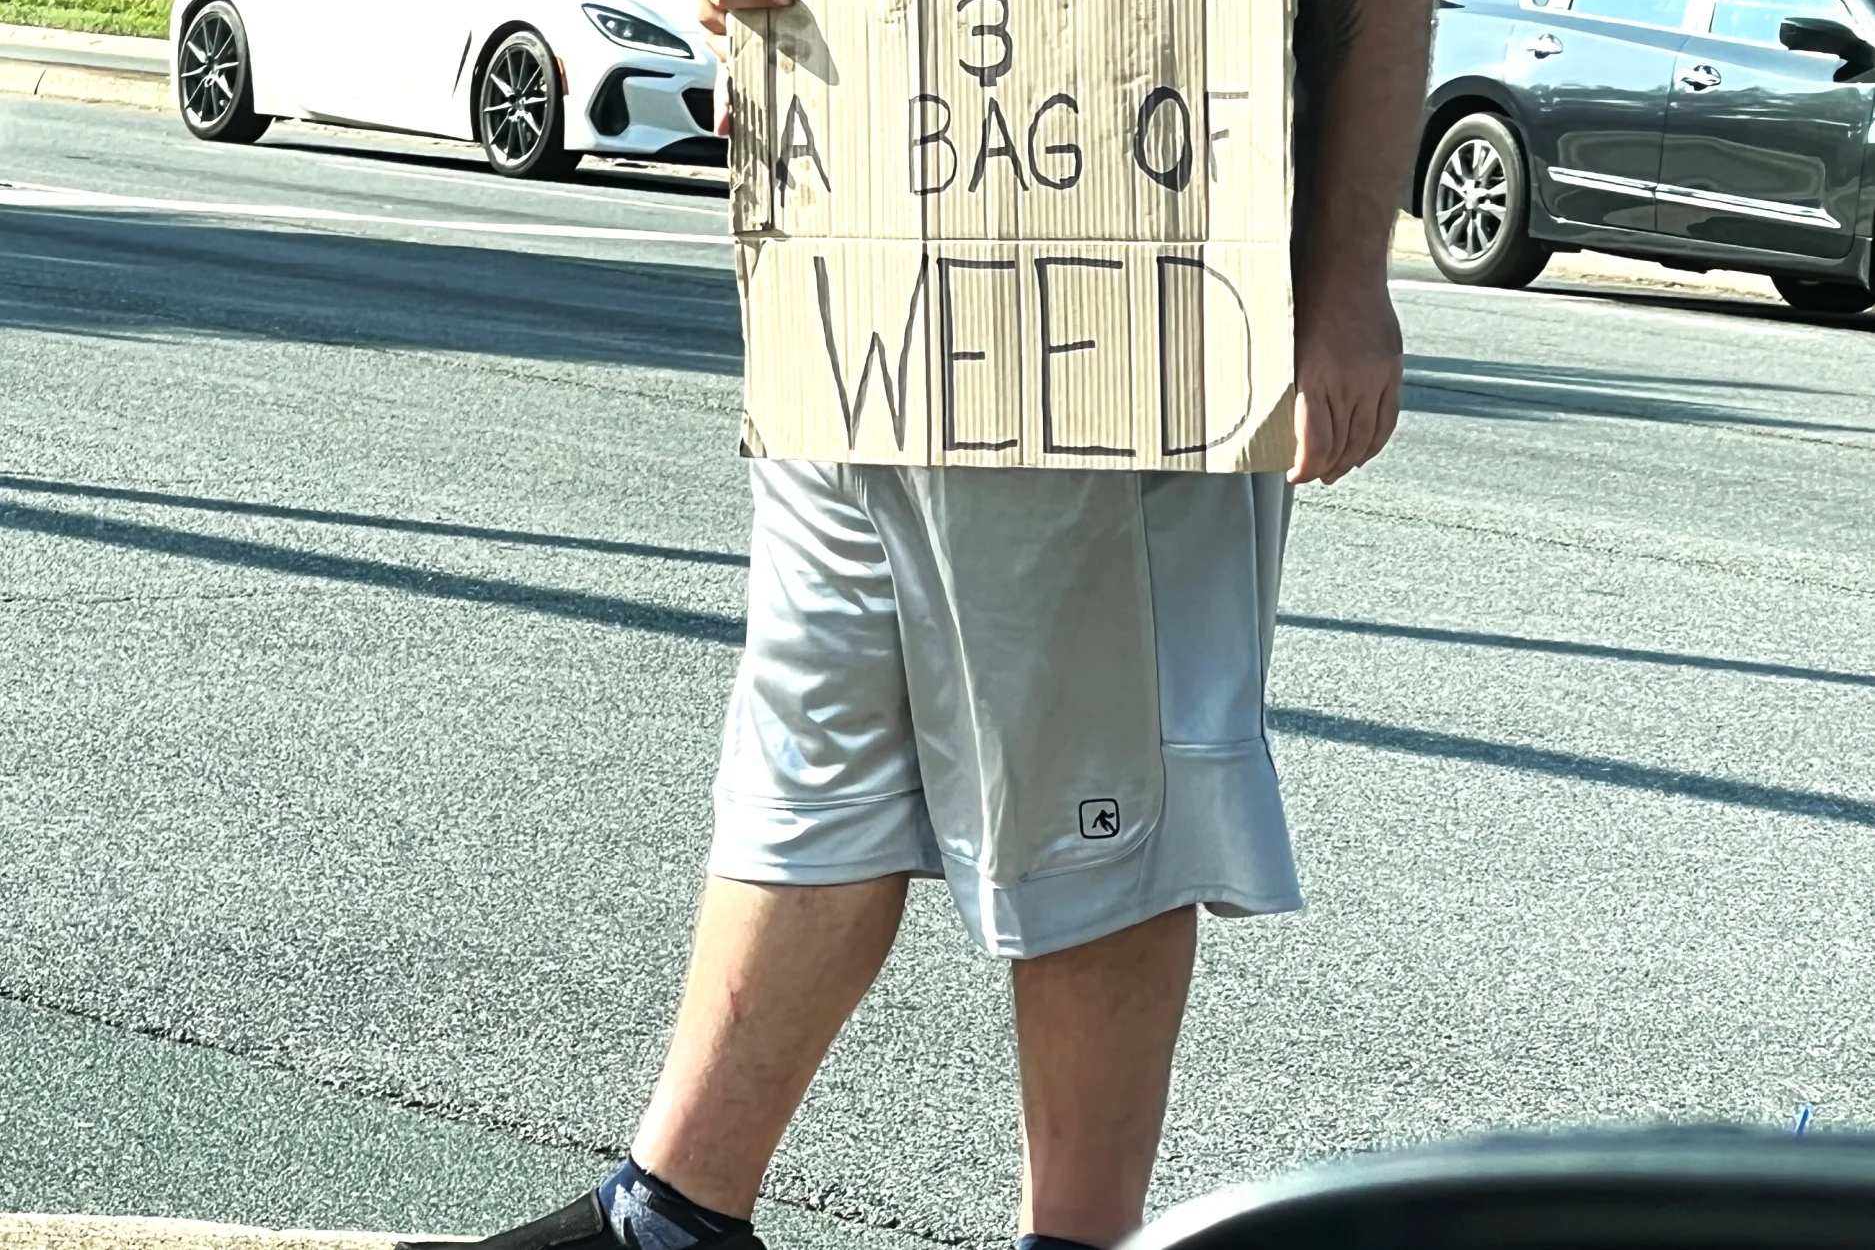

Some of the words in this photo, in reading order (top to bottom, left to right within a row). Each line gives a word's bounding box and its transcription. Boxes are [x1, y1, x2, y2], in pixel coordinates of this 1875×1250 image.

[775, 94, 832, 196] A
[908, 92, 1084, 196] BAG
[1133, 86, 1250, 192] OF
[813, 253, 1253, 457] WEED
